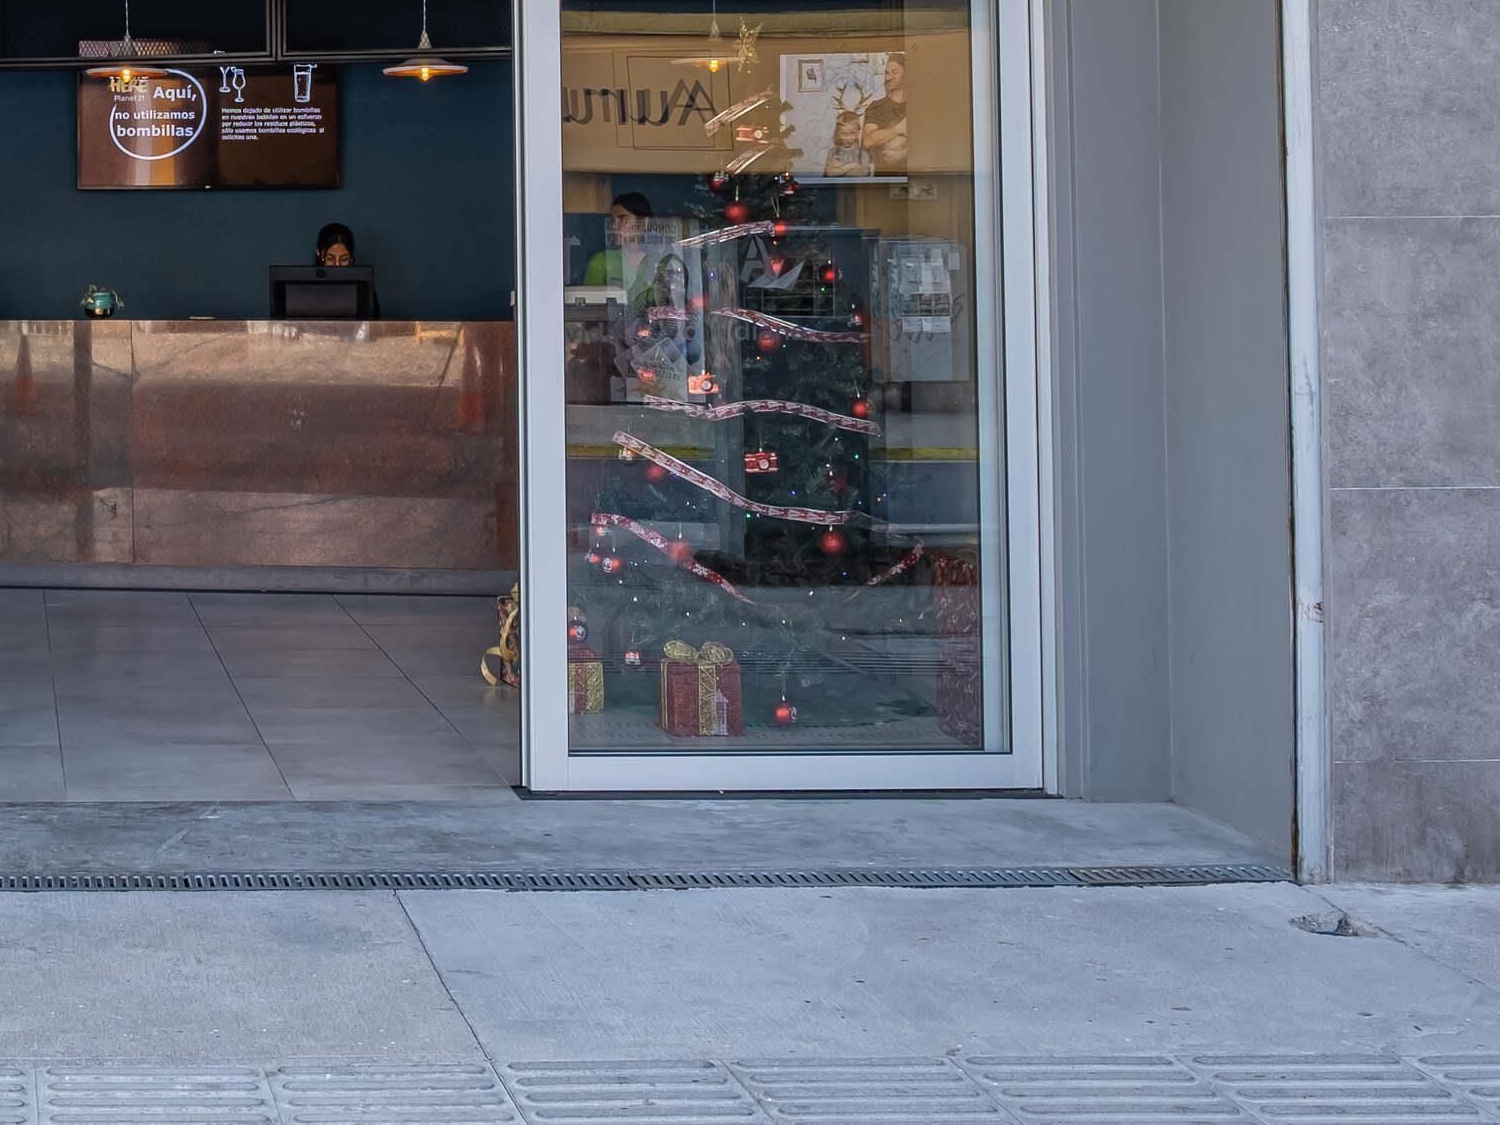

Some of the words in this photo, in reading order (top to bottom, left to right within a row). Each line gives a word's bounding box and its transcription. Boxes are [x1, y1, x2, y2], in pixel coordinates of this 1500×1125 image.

[153, 85, 197, 101] Aquí,
[115, 112, 130, 120] no
[133, 109, 196, 120] utilizamos
[117, 125, 194, 137] bombillas
